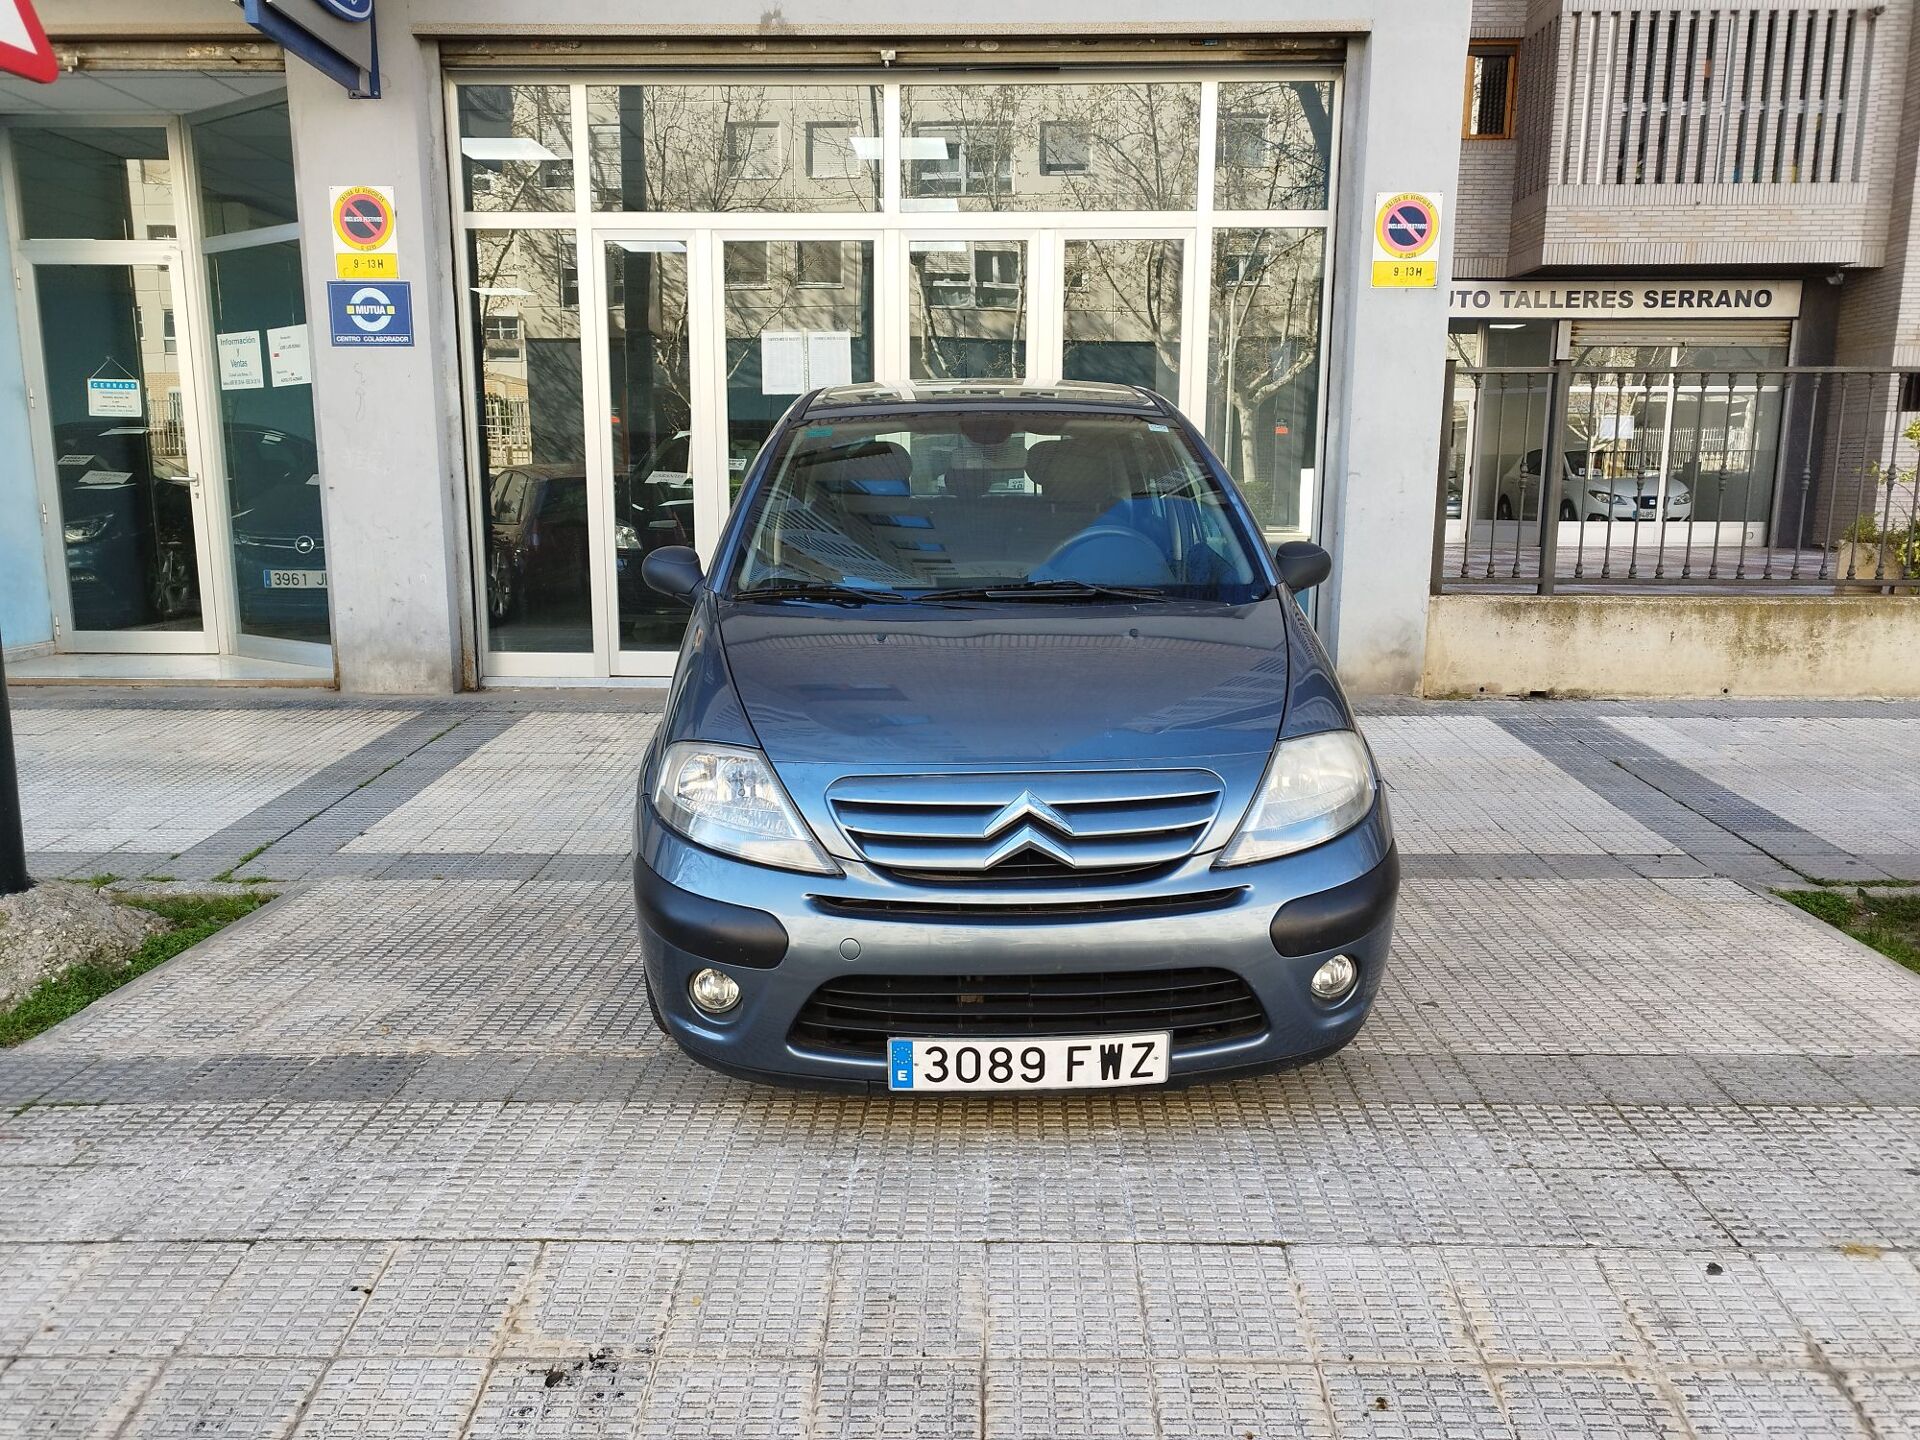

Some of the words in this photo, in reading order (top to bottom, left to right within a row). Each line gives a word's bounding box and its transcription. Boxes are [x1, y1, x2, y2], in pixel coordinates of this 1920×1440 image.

[1500, 290, 1634, 309] TALLERES
[1642, 289, 1773, 308] SERRANO
[355, 305, 386, 315] MUTUA
[220, 336, 256, 346] Información
[336, 335, 361, 343] CENTRO
[363, 335, 409, 343] COLABORADOR
[230, 359, 248, 368] Ventas
[274, 572, 307, 586] 3961
[897, 1070, 908, 1081] E
[924, 1046, 1046, 1083] 3089
[1066, 1042, 1155, 1082] FWZ
